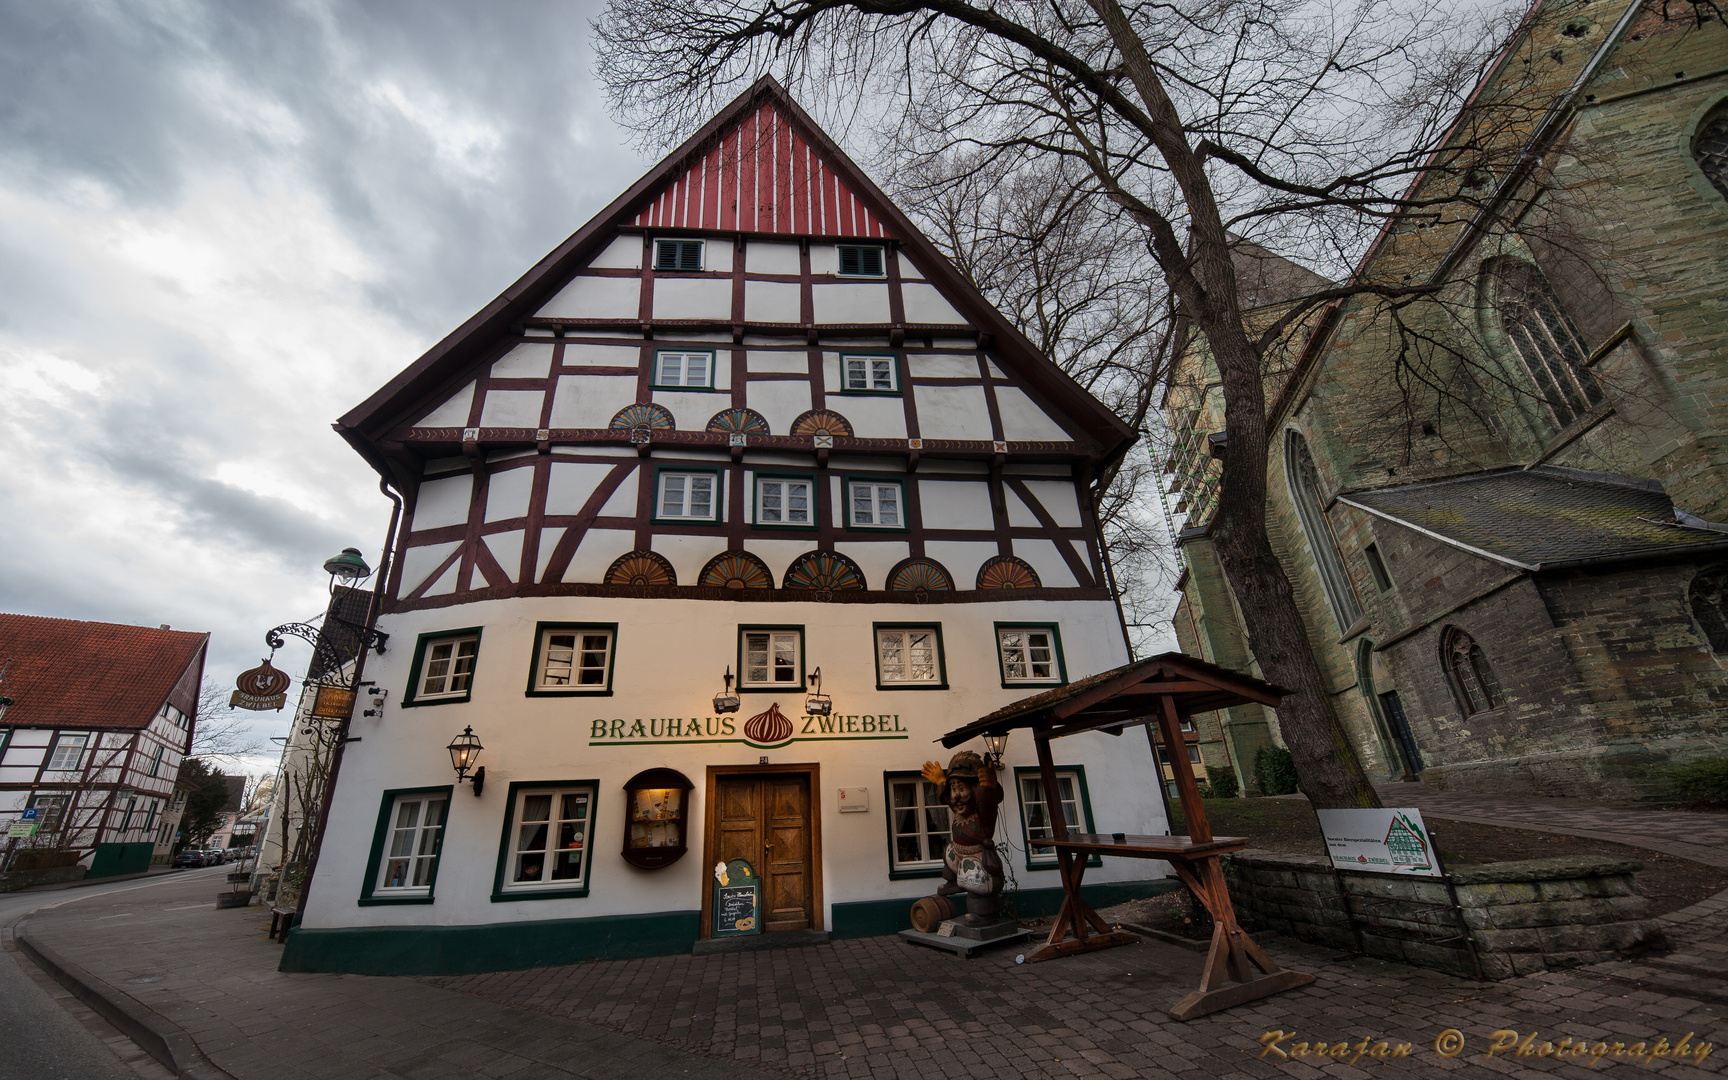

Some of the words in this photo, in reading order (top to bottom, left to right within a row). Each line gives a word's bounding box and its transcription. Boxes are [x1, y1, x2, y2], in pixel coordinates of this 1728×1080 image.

[239, 692, 281, 702] BRAUHAUS
[239, 699, 278, 709] ZWIEBEL
[590, 717, 736, 740] BRAUHAUS
[800, 714, 908, 735] ZWIEBEL
[25, 809, 35, 818] P
